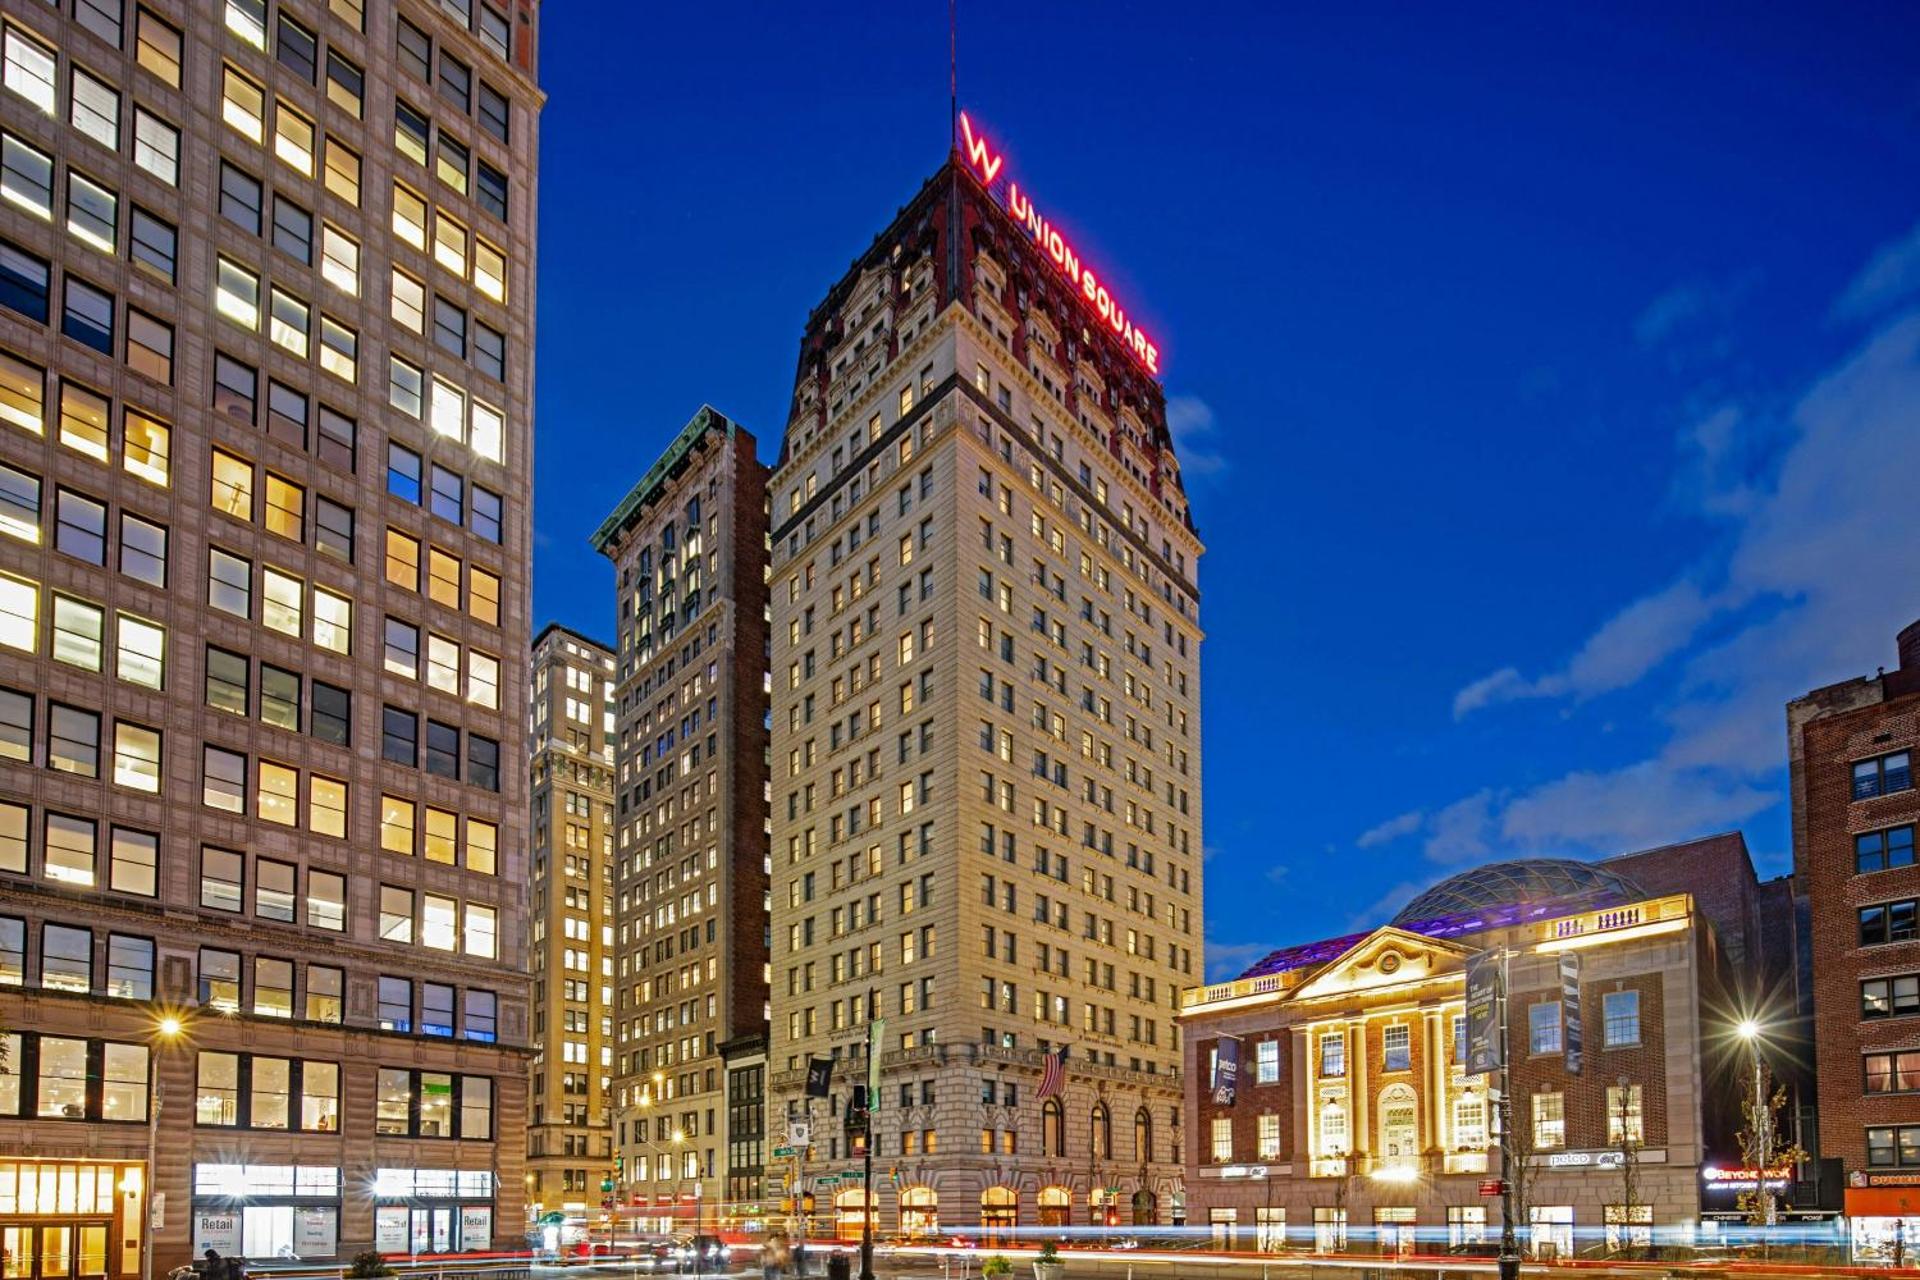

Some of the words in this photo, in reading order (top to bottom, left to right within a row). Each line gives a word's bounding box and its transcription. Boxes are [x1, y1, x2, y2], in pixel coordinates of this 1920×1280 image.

[960, 110, 1002, 184] W
[1010, 182, 1080, 284] UNION
[1082, 269, 1159, 375] SQUARE
[1551, 1153, 1590, 1166] petco
[201, 1218, 233, 1230] Retail
[464, 1216, 487, 1227] Retail
